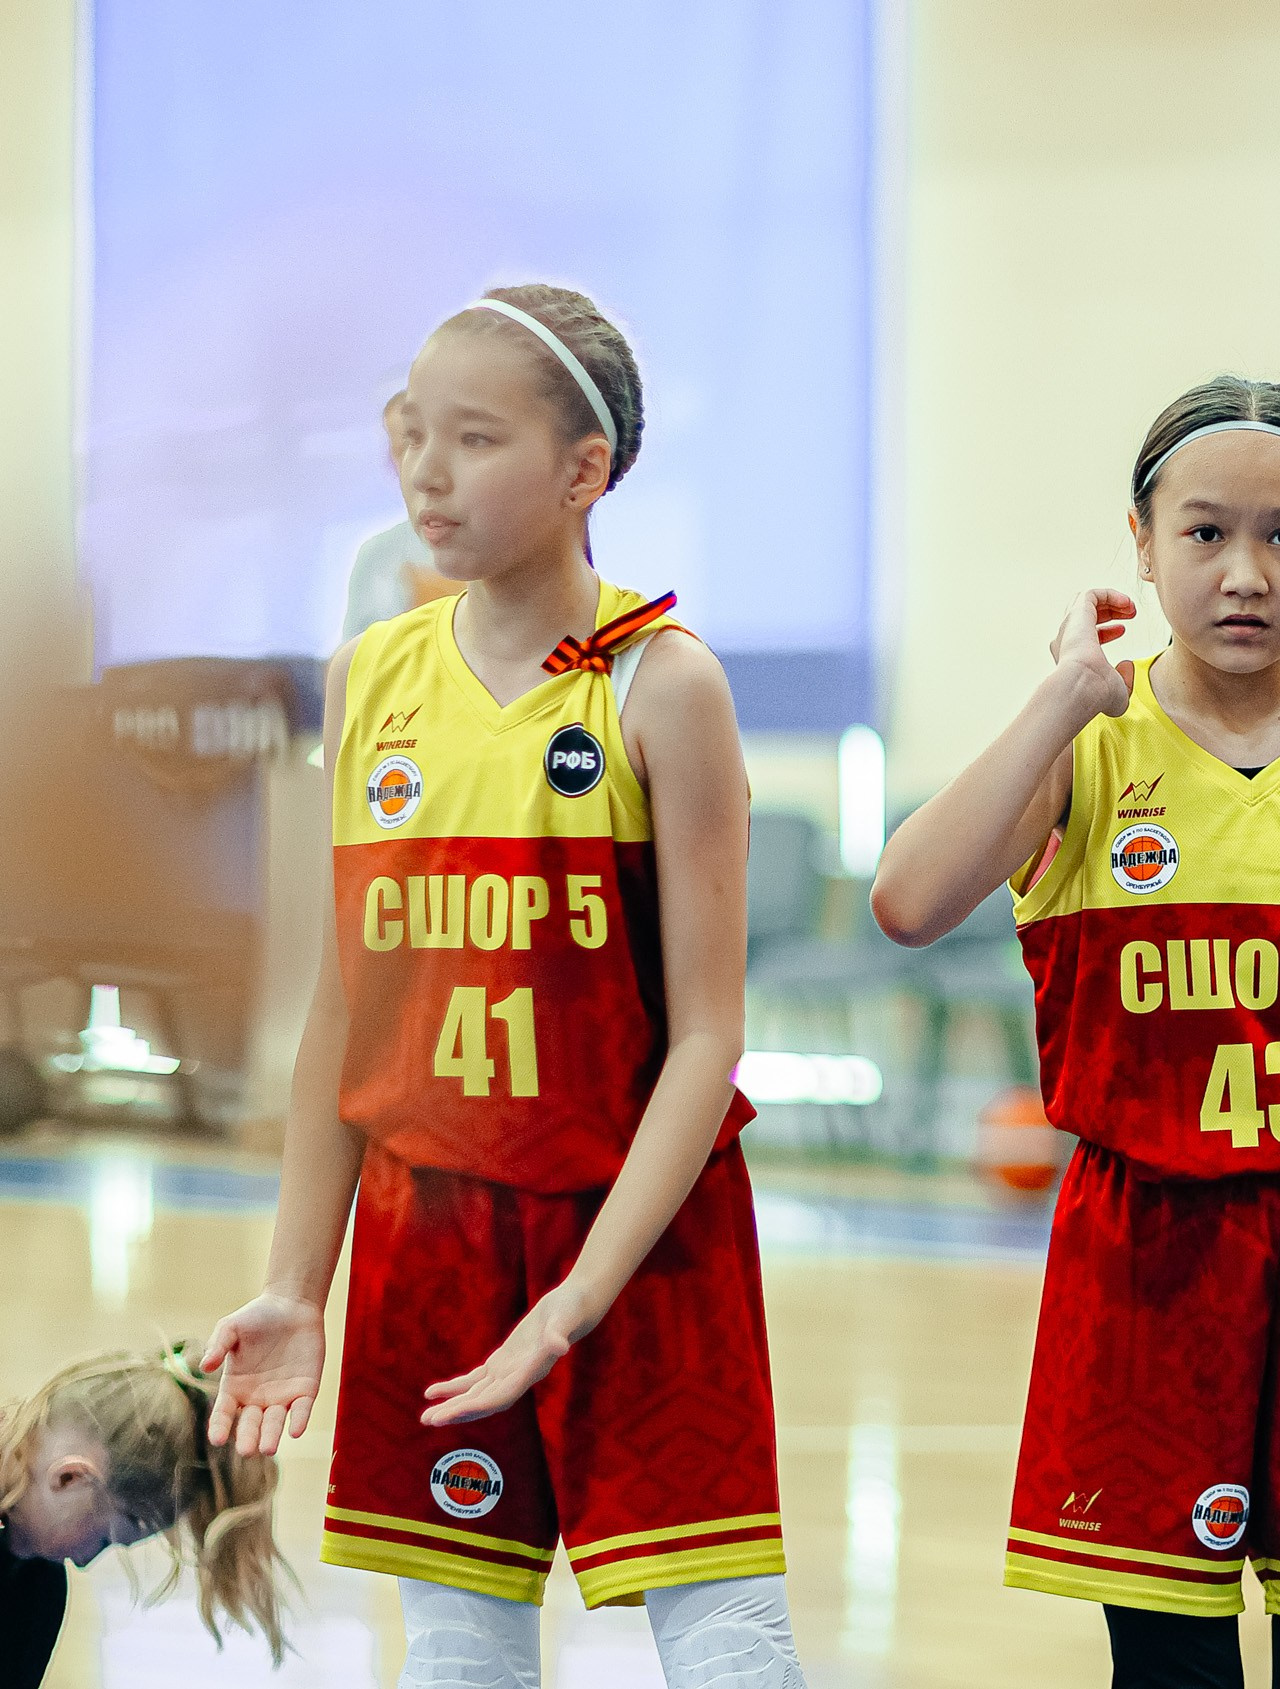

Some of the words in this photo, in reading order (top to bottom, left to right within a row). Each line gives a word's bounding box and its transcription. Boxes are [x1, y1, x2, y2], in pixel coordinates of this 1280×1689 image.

[376, 739, 418, 752] WINRISE
[552, 750, 597, 770] РФБ
[367, 781, 421, 802] НАДЕЖДА
[1117, 806, 1167, 819] WINRISE
[1111, 848, 1177, 869] НАДЕЖДА
[363, 873, 550, 952] СШОР
[566, 873, 608, 949] 5
[433, 986, 540, 1097] 41
[432, 1468, 501, 1496] НАДЕЖДА
[1058, 1518, 1102, 1532] WINRISE
